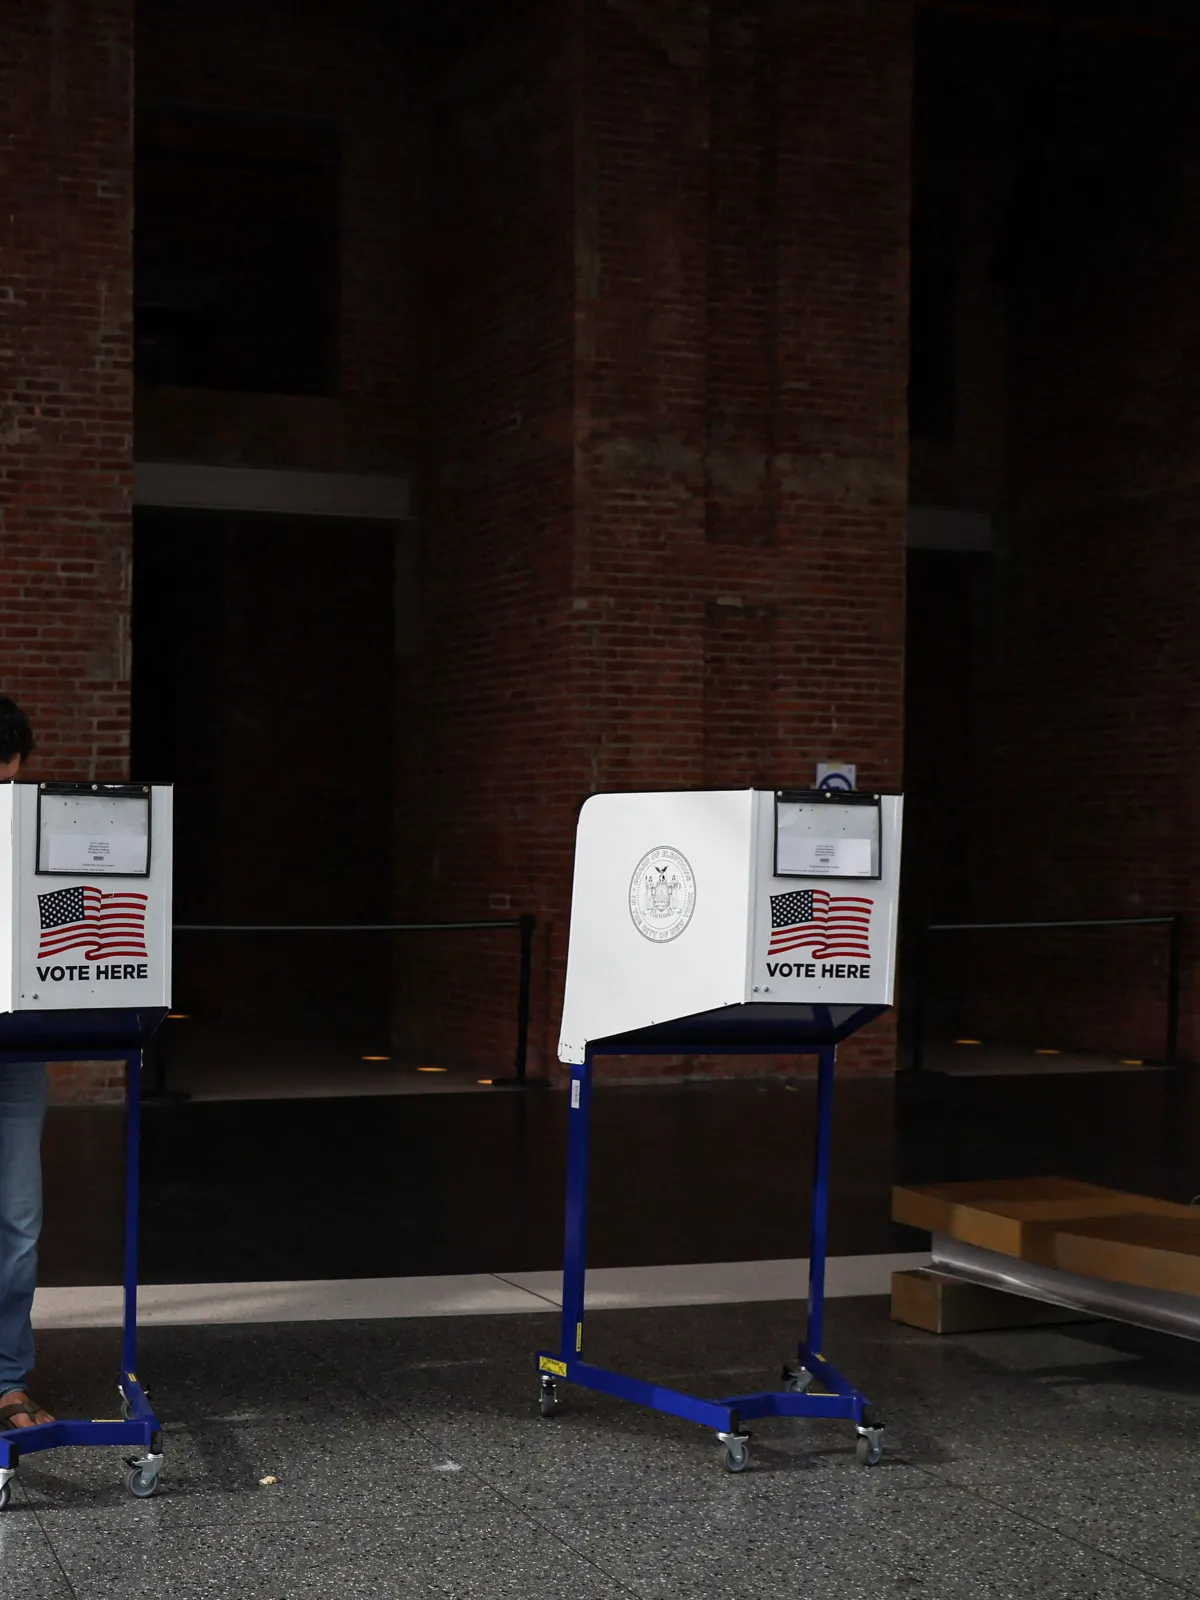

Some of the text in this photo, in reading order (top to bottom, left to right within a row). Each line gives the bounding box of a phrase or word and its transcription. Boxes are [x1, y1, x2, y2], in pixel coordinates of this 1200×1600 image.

[36, 964, 148, 982] VOTE HERE
[766, 962, 870, 979] VOTE HERE
